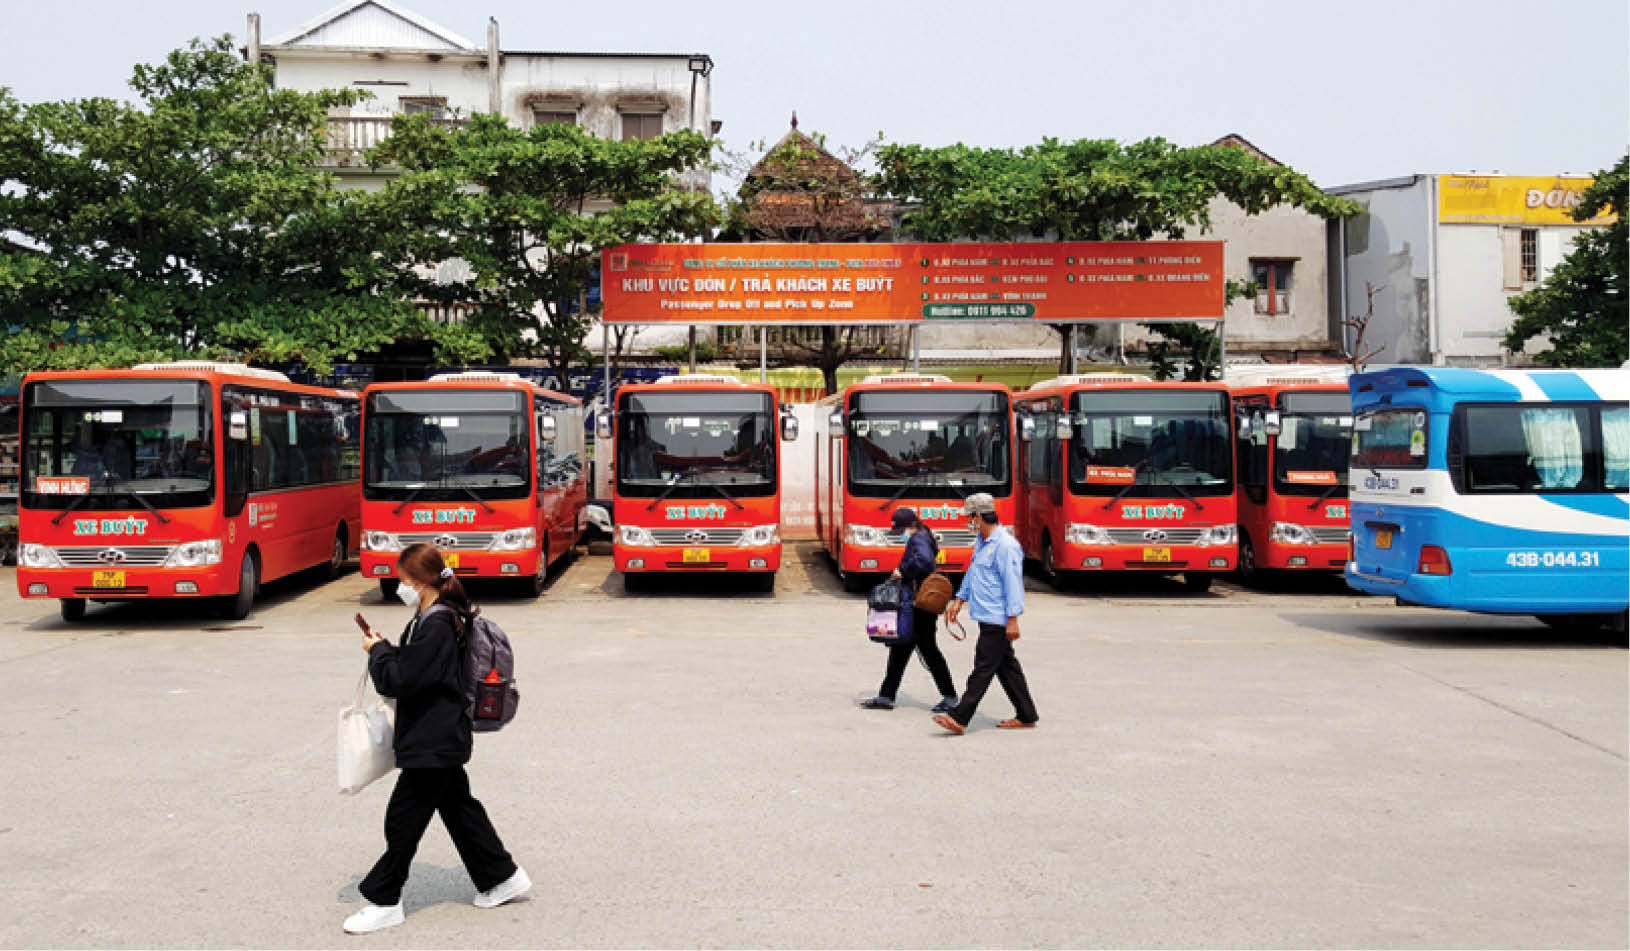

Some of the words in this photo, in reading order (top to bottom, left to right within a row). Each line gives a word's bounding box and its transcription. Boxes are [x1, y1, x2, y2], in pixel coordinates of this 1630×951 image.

[622, 278, 653, 293] KHU
[658, 276, 690, 295] VỰC
[694, 275, 726, 293] ĐÓN
[728, 278, 737, 293] /
[742, 272, 772, 293] TRẢ
[776, 275, 828, 293] KHÁCH
[832, 278, 852, 293] XE
[856, 274, 895, 293] BUÝT
[660, 299, 714, 311] Passenger
[717, 299, 742, 311] Drop
[745, 299, 761, 310] Off
[763, 299, 782, 310] and
[785, 299, 808, 310] Pick
[811, 300, 826, 311] Up
[828, 299, 854, 310] Zone
[412, 509, 433, 523] XE
[435, 506, 476, 523] BUÝT
[665, 506, 685, 520] XE
[687, 502, 726, 520] BUÝT
[919, 503, 960, 520] BUÝT
[1121, 505, 1143, 519] XE
[1145, 502, 1185, 519] BUÝT
[1325, 505, 1346, 519] XE
[73, 519, 98, 535] XE
[100, 515, 148, 535] BUÝT
[1506, 551, 1600, 567] 43B-044.31
